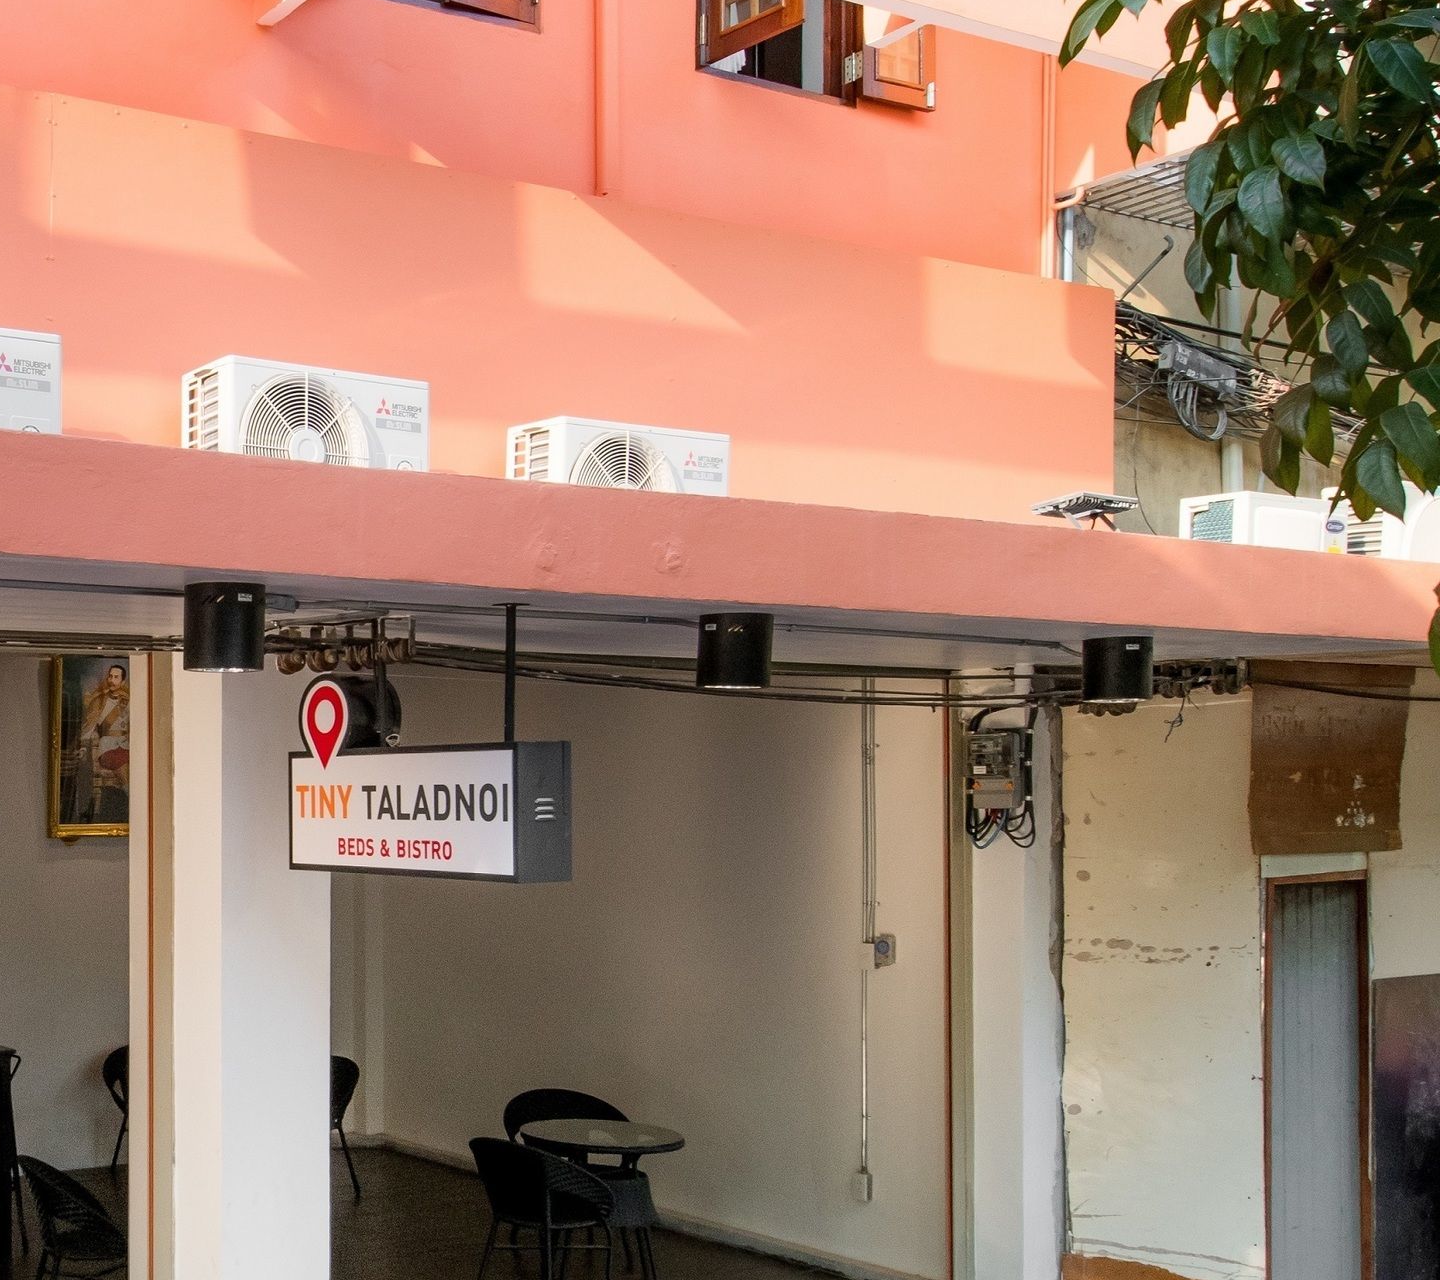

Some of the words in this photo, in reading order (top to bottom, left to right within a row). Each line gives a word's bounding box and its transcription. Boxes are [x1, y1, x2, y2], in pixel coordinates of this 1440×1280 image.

[13, 358, 51, 370] MITSUBISHI
[13, 365, 46, 376] ELECTRIC
[296, 785, 352, 818] TINY
[362, 783, 508, 822] TALADNOI
[338, 837, 374, 856] BEDS
[380, 838, 390, 857] &
[397, 839, 452, 860] BISTRO
